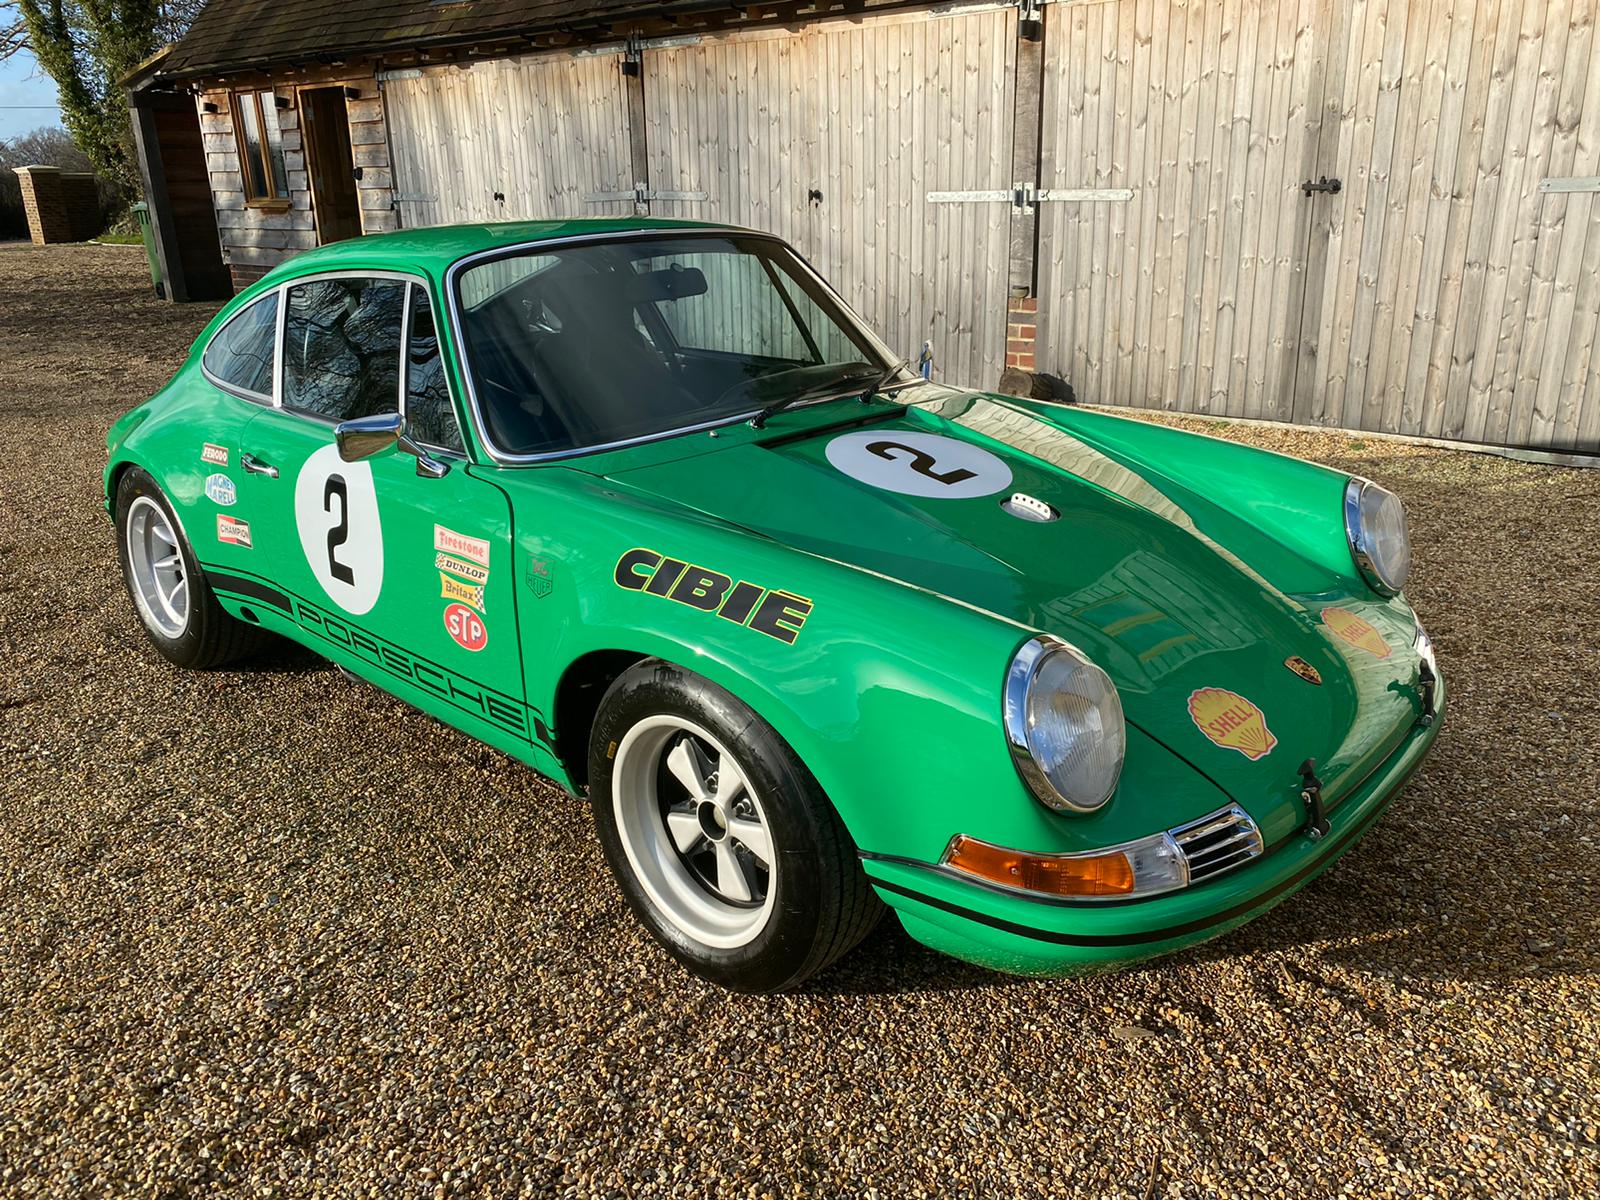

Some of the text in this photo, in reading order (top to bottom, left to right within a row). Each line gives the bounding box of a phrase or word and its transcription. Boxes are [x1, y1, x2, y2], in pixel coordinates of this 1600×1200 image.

[865, 441, 978, 485] 2
[220, 524, 250, 539] CHAMPION
[324, 473, 355, 587] 2
[440, 531, 484, 558] Firestone
[446, 560, 486, 580] DUNLOP
[445, 580, 475, 602] Britax
[449, 608, 482, 644] STP
[1340, 621, 1371, 643] SHELL
[297, 602, 526, 731] PORSCHE
[1207, 704, 1253, 738] SHELL
